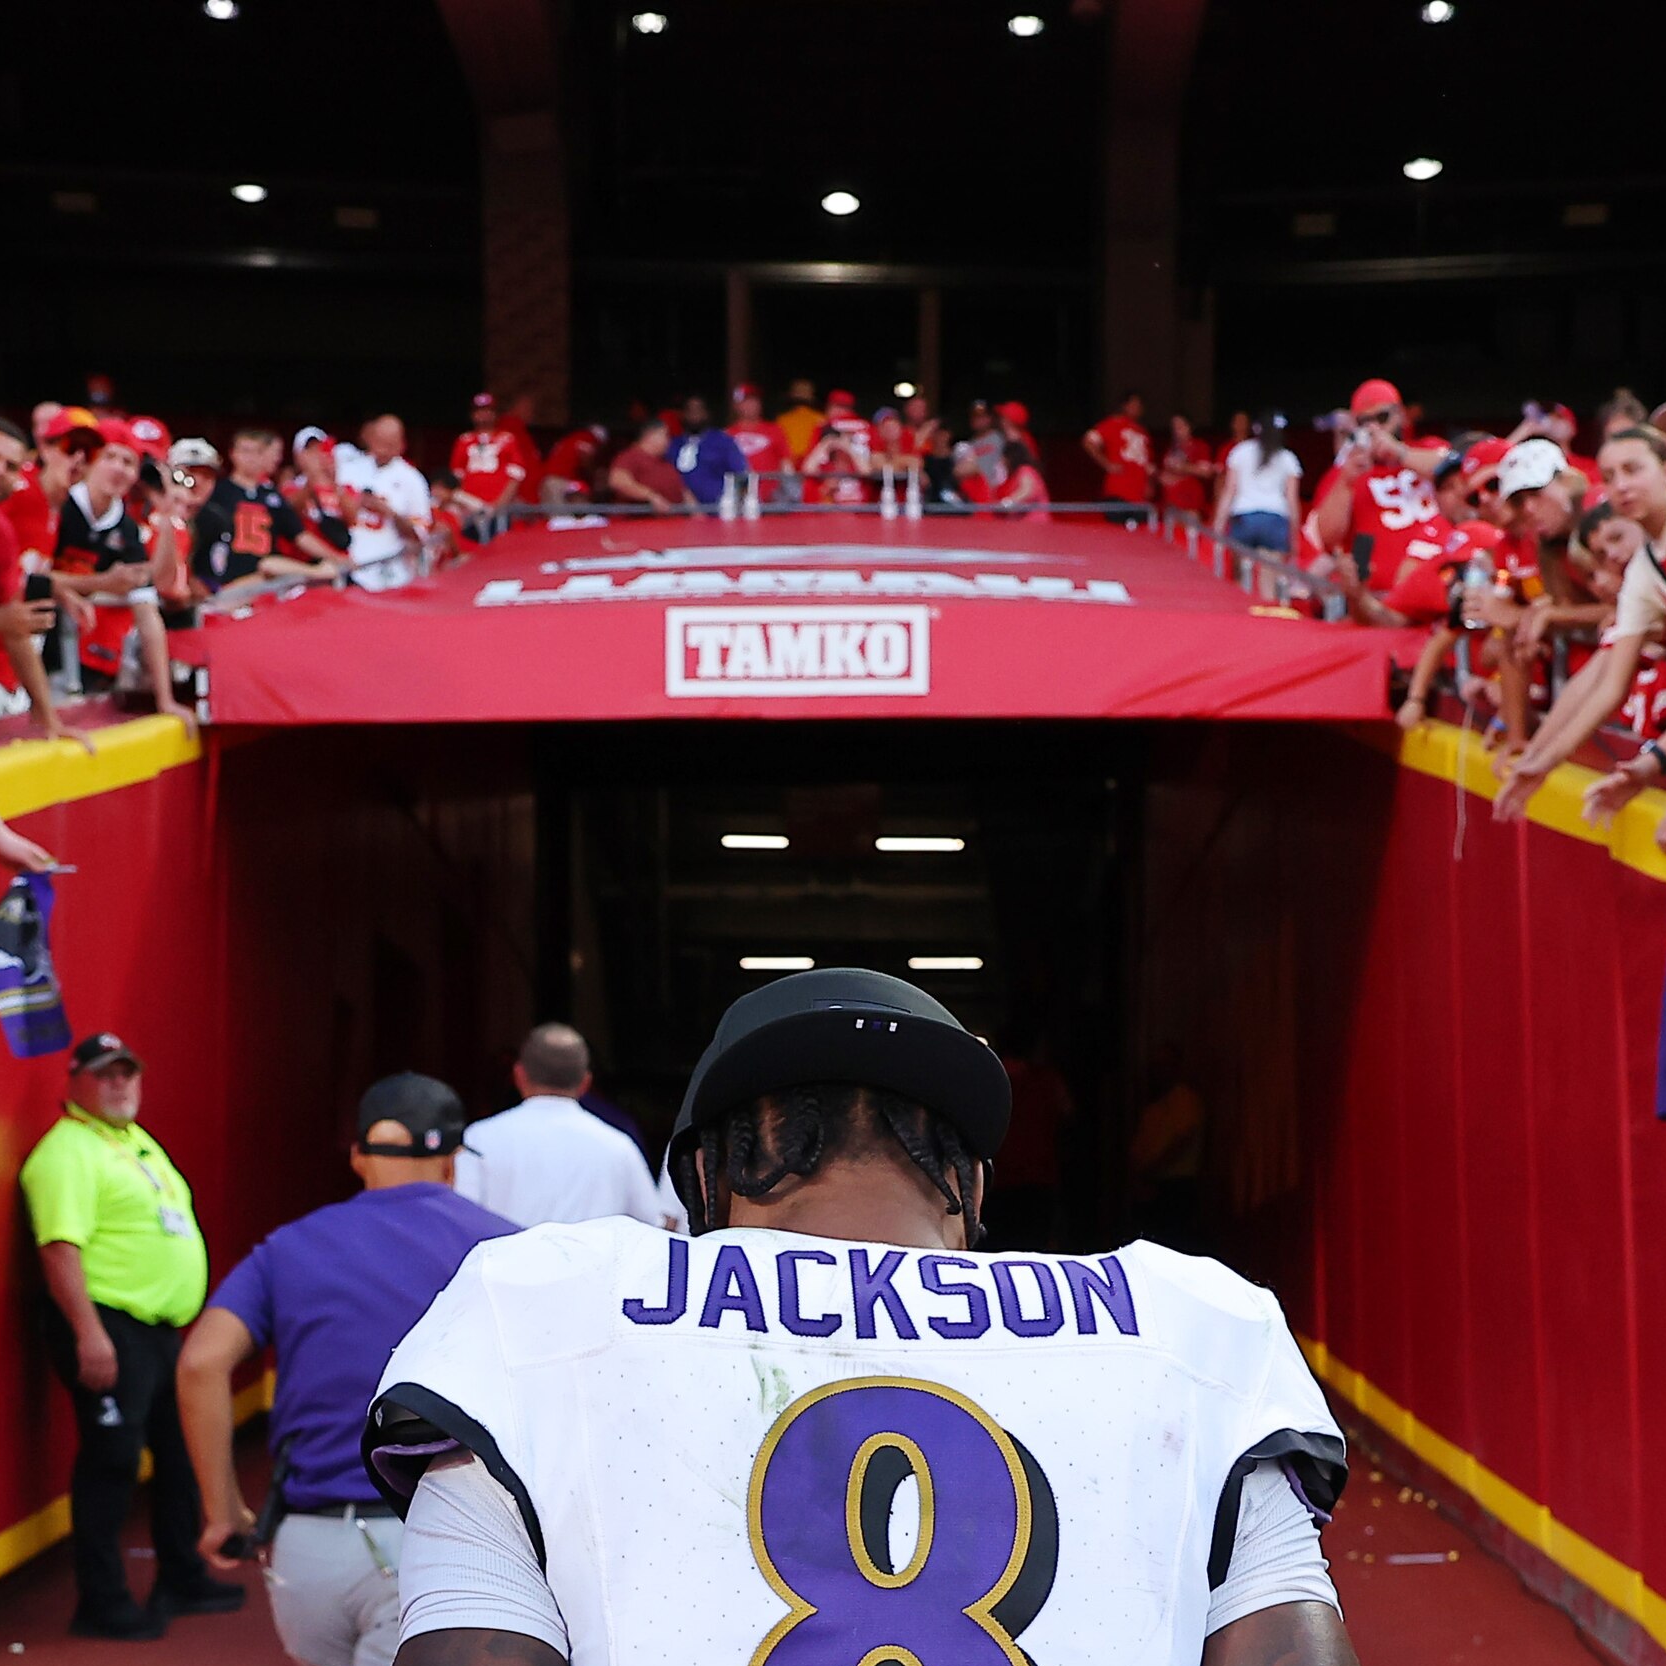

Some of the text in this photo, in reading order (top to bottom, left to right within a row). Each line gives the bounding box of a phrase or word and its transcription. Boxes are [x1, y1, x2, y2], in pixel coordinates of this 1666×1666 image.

[234, 503, 273, 555] 15
[686, 622, 910, 679] TAMKO
[621, 1238, 1141, 1340] JACKSON
